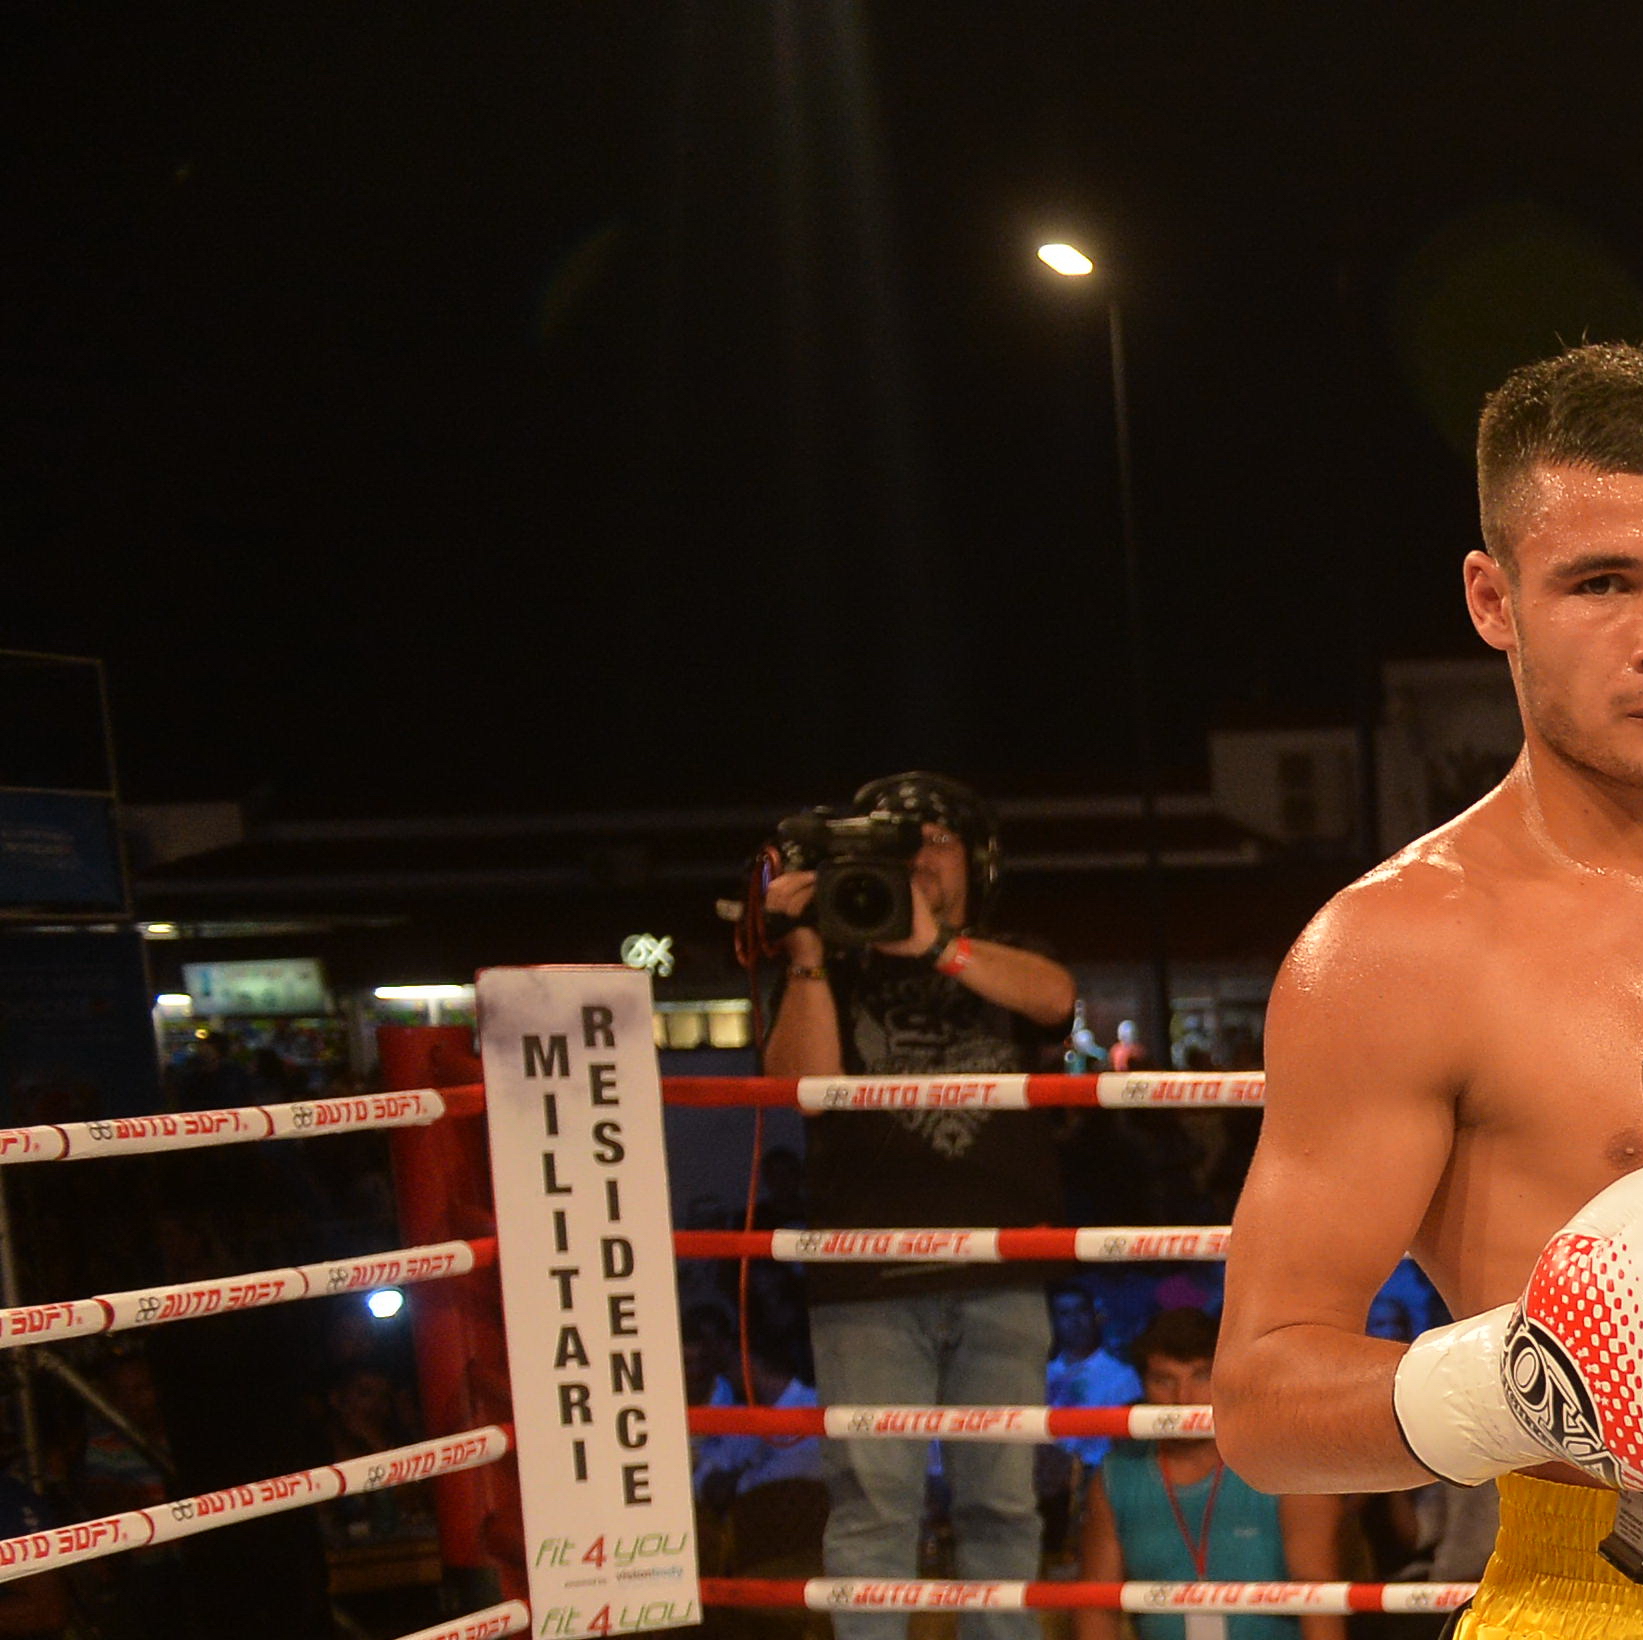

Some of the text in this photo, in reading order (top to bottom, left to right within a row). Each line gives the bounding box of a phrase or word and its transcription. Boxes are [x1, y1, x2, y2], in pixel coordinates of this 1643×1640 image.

[315, 1095, 423, 1126] AUTO SOFT
[852, 1084, 996, 1107] AUTO SOFT
[116, 1111, 240, 1139] AUTO SOFT
[347, 1254, 455, 1288] AUTO SOFT
[522, 1035, 593, 1481] MILITARI
[581, 1005, 652, 1506] RESIDENCE
[159, 1281, 286, 1319] AUTO SOFT
[11, 1303, 75, 1335] SOFT
[384, 1436, 489, 1484] AUTO SOFT
[197, 1471, 315, 1517] AUTO SOFT
[59, 1519, 121, 1554] SOFT
[581, 1534, 607, 1567] 4
[614, 1532, 687, 1566] you
[587, 1603, 613, 1634] 4
